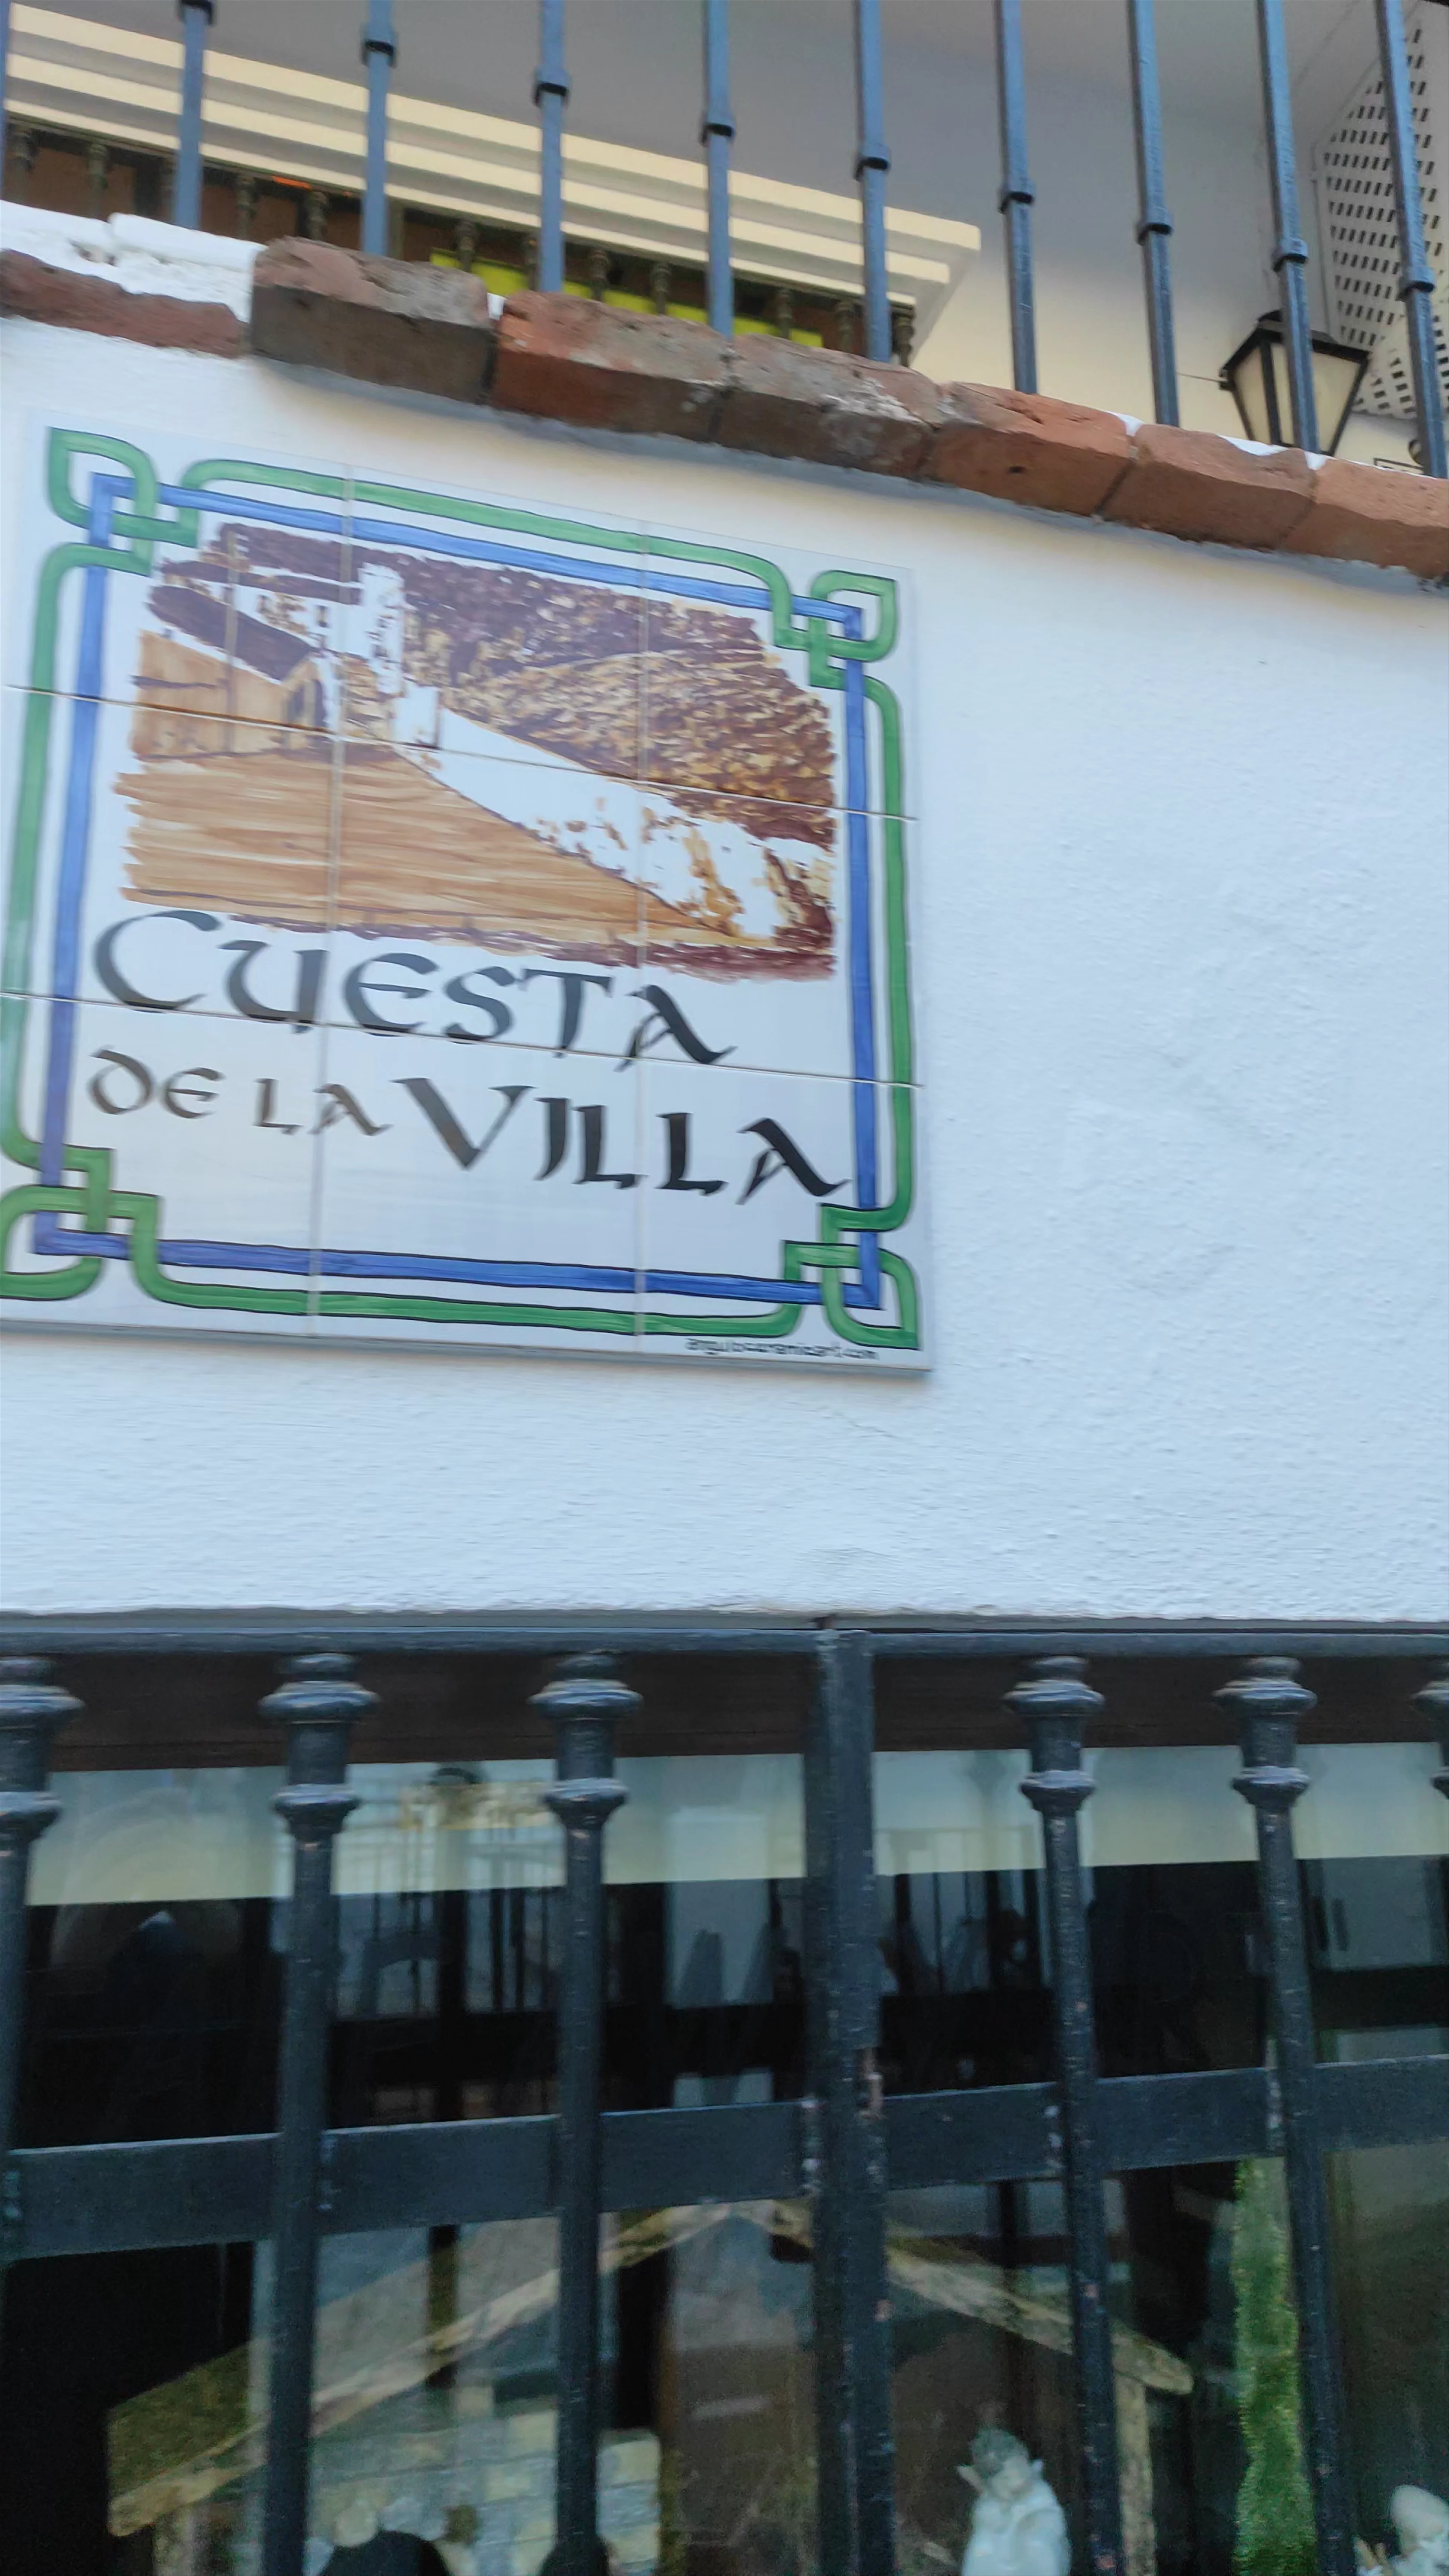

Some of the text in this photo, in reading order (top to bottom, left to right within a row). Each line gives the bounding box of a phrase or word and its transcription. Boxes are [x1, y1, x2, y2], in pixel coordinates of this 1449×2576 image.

[93, 910, 738, 1072] CUESTA
[87, 1046, 852, 1205] DE LA VILLA
